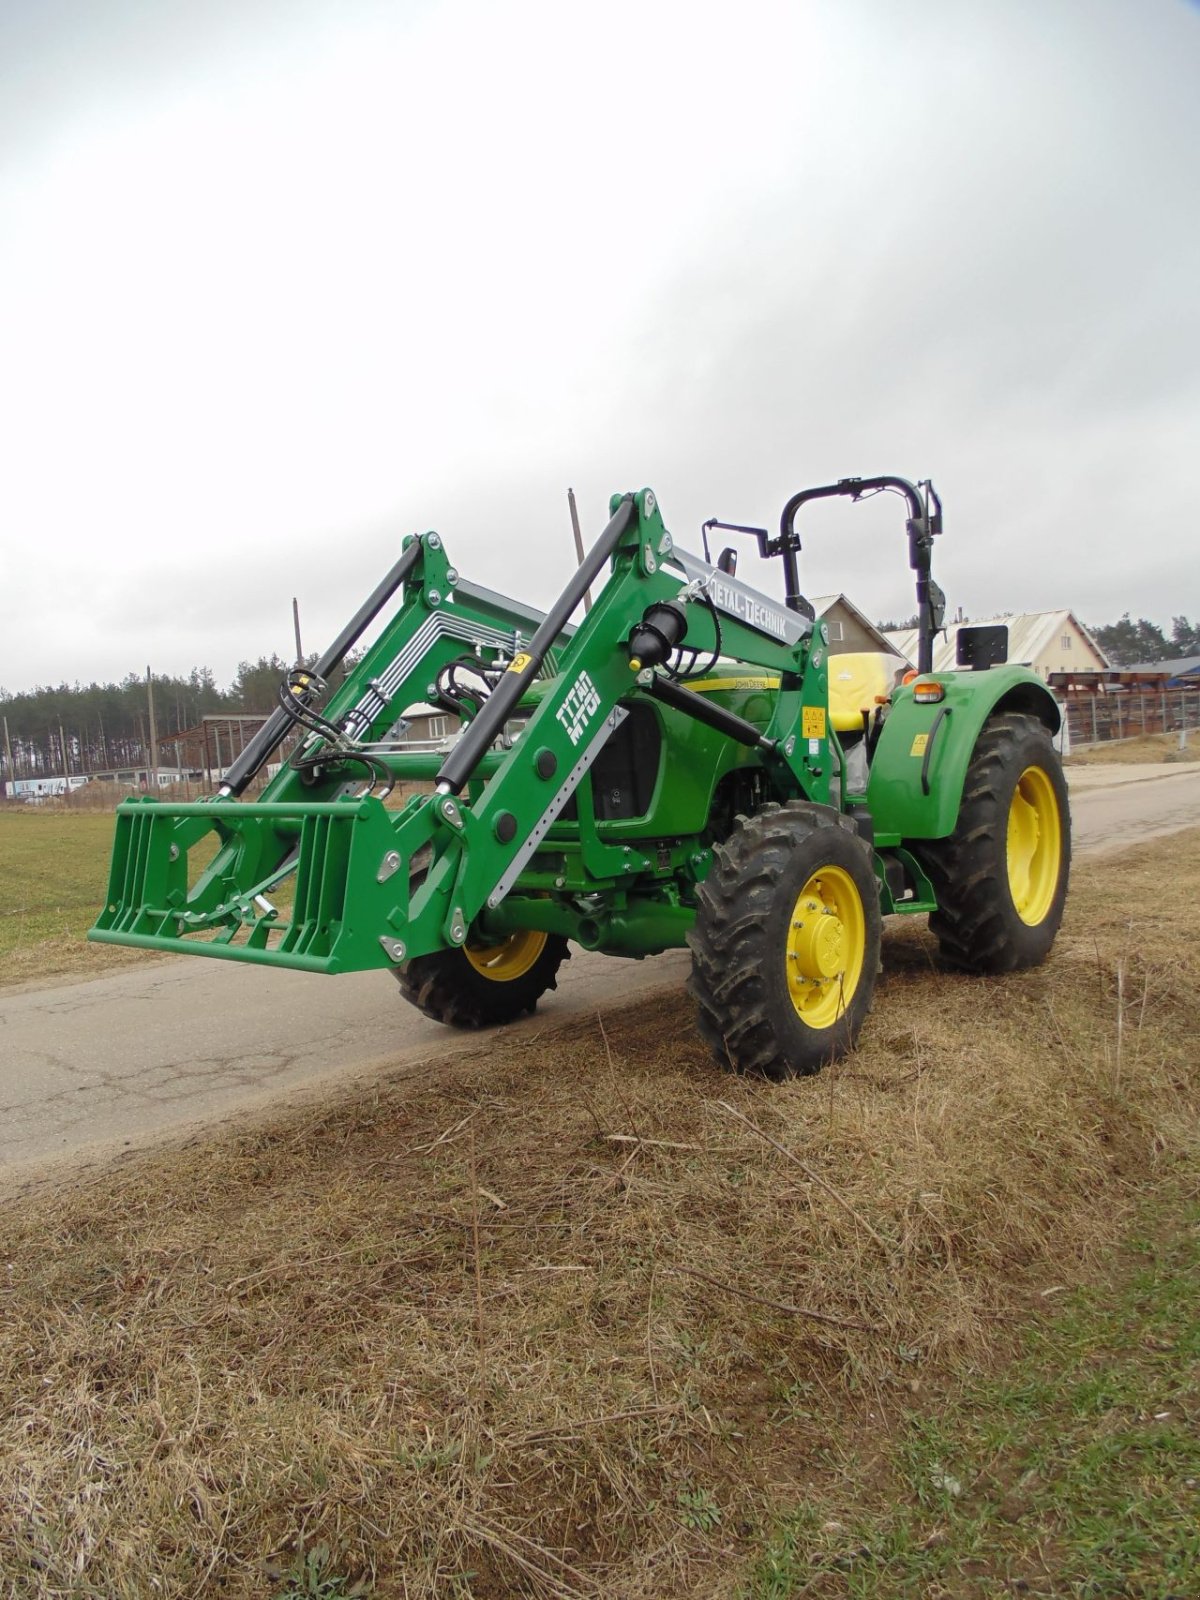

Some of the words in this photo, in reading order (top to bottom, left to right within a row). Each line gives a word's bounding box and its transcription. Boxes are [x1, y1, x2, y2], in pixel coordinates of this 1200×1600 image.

[555, 669, 593, 729] TYTAN
[735, 679, 749, 689] JOHN
[749, 679, 767, 689] DEERE
